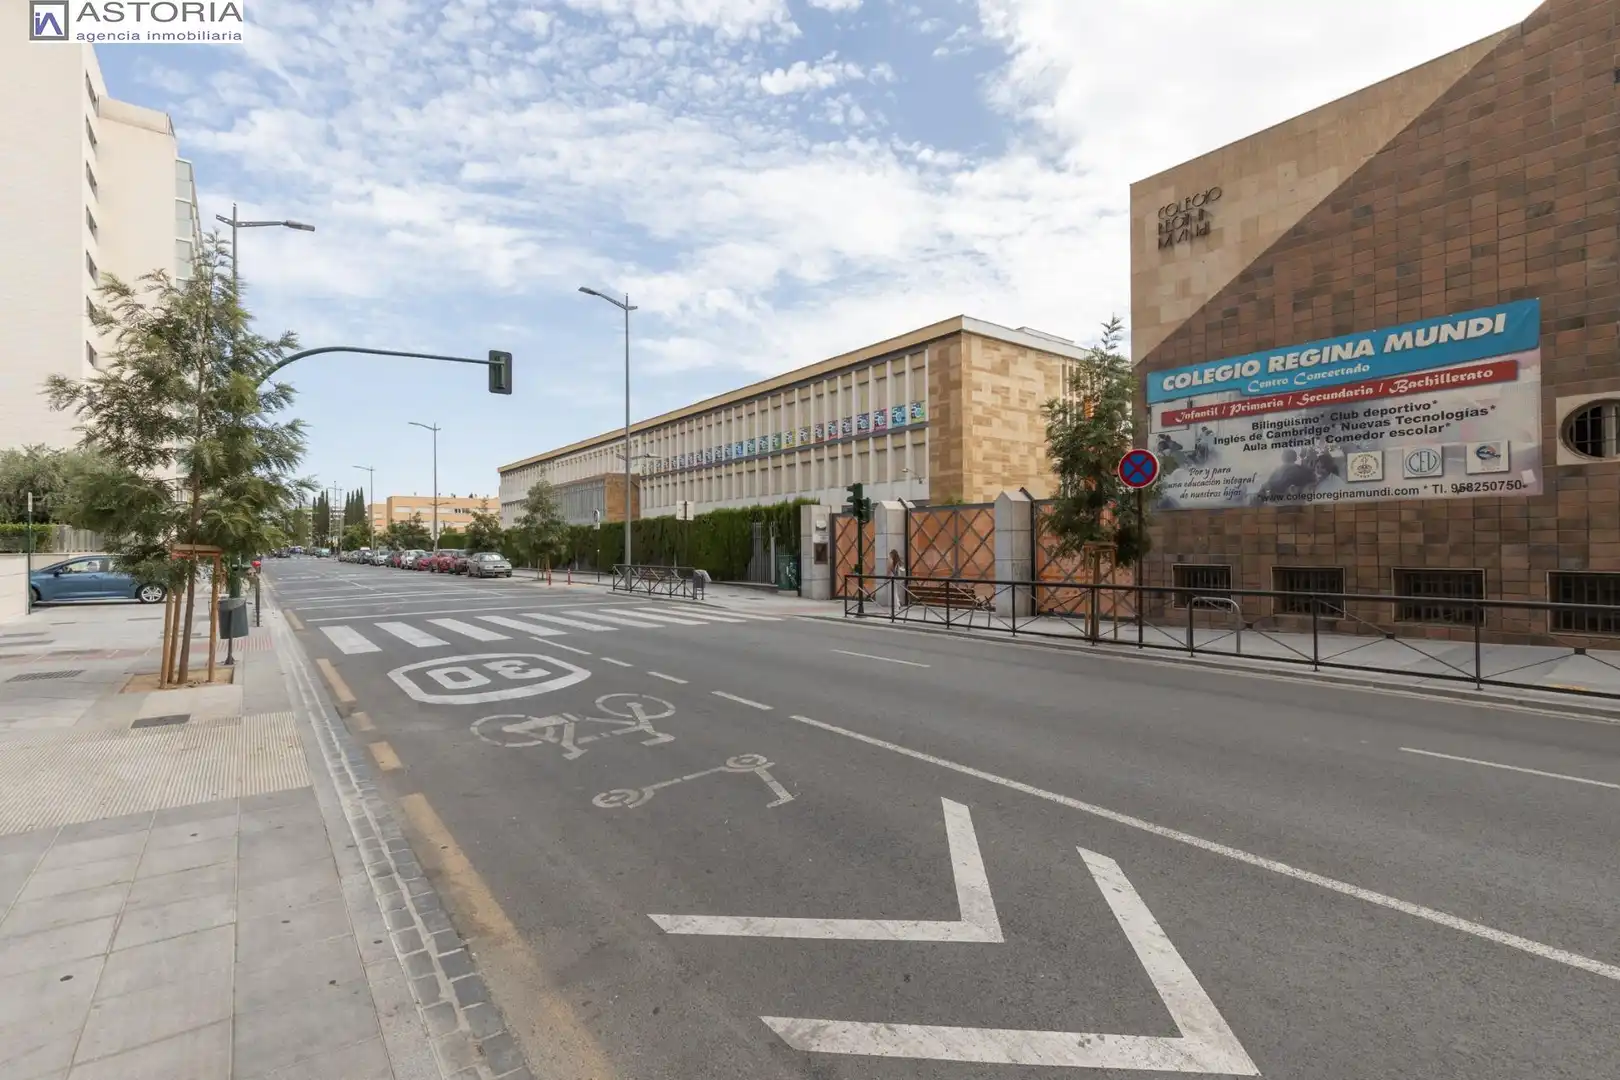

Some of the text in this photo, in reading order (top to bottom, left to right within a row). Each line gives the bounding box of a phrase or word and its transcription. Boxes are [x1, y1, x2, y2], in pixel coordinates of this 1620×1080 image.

[1163, 313, 1506, 391] COLEGIO REGINA MUNDI
[1248, 363, 1370, 392] Centro Concertado
[1175, 407, 1218, 422] Infantil
[1230, 399, 1284, 416] Primaria
[1296, 385, 1373, 406] Secundaria
[1389, 369, 1493, 393] Bachillerato
[1330, 410, 1359, 422] Club
[1214, 434, 1246, 446] Inglés
[1249, 433, 1262, 441] de
[1341, 419, 1391, 432] Nuevas
[1243, 440, 1268, 452] Aula
[1325, 430, 1385, 444] Comedor
[1184, 477, 1221, 488] educación
[1223, 472, 1257, 489] integral
[1211, 467, 1231, 478] para
[1180, 489, 1189, 499] de
[426, 660, 551, 690] 30
